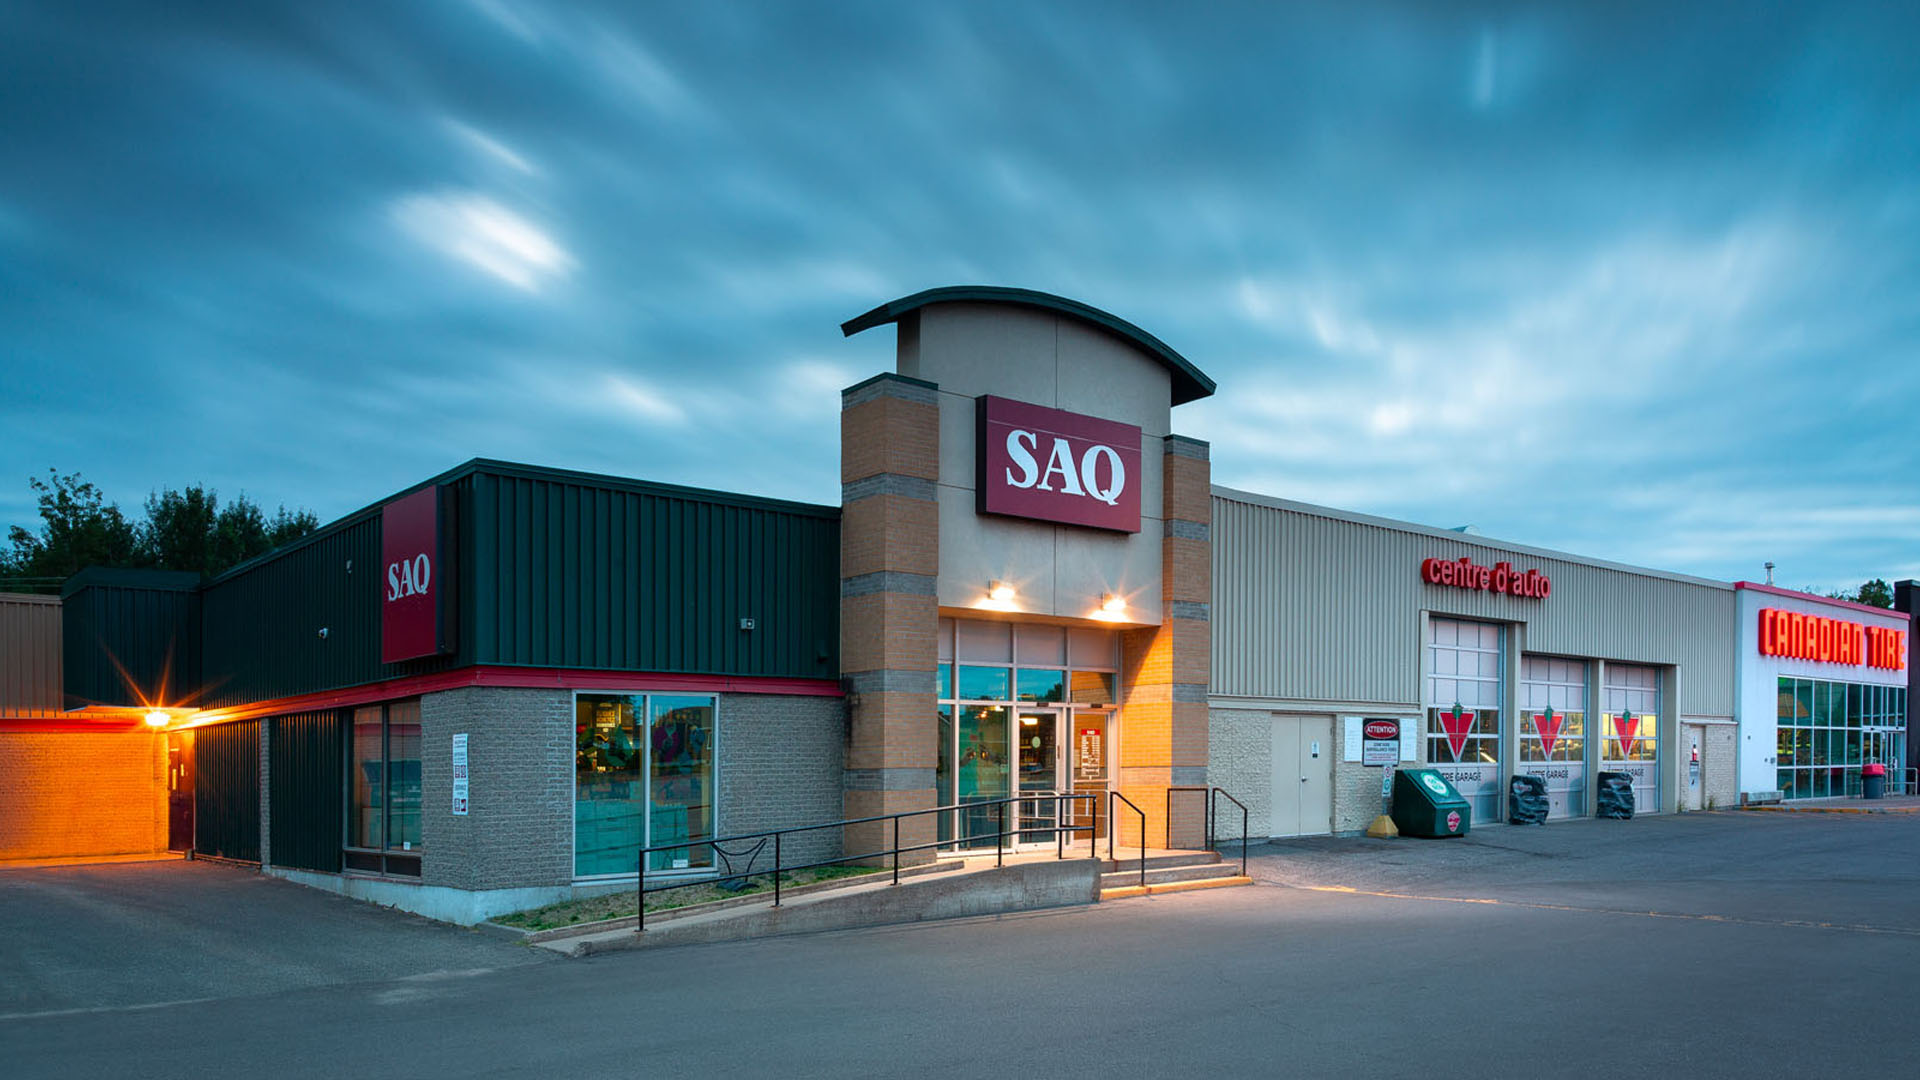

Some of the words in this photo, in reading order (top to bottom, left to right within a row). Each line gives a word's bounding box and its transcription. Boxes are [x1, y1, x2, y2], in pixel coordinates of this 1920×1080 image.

[1006, 429, 1125, 506] SAQ
[388, 553, 430, 602] SAQ
[1421, 557, 1490, 591] centre
[1495, 562, 1551, 599] d'auto
[1758, 608, 1864, 666] CANADIAN
[1865, 626, 1906, 670] TIRE
[1367, 726, 1396, 734] ATTENTION
[1455, 772, 1481, 781] GARAGE
[1546, 770, 1568, 779] GARAGE
